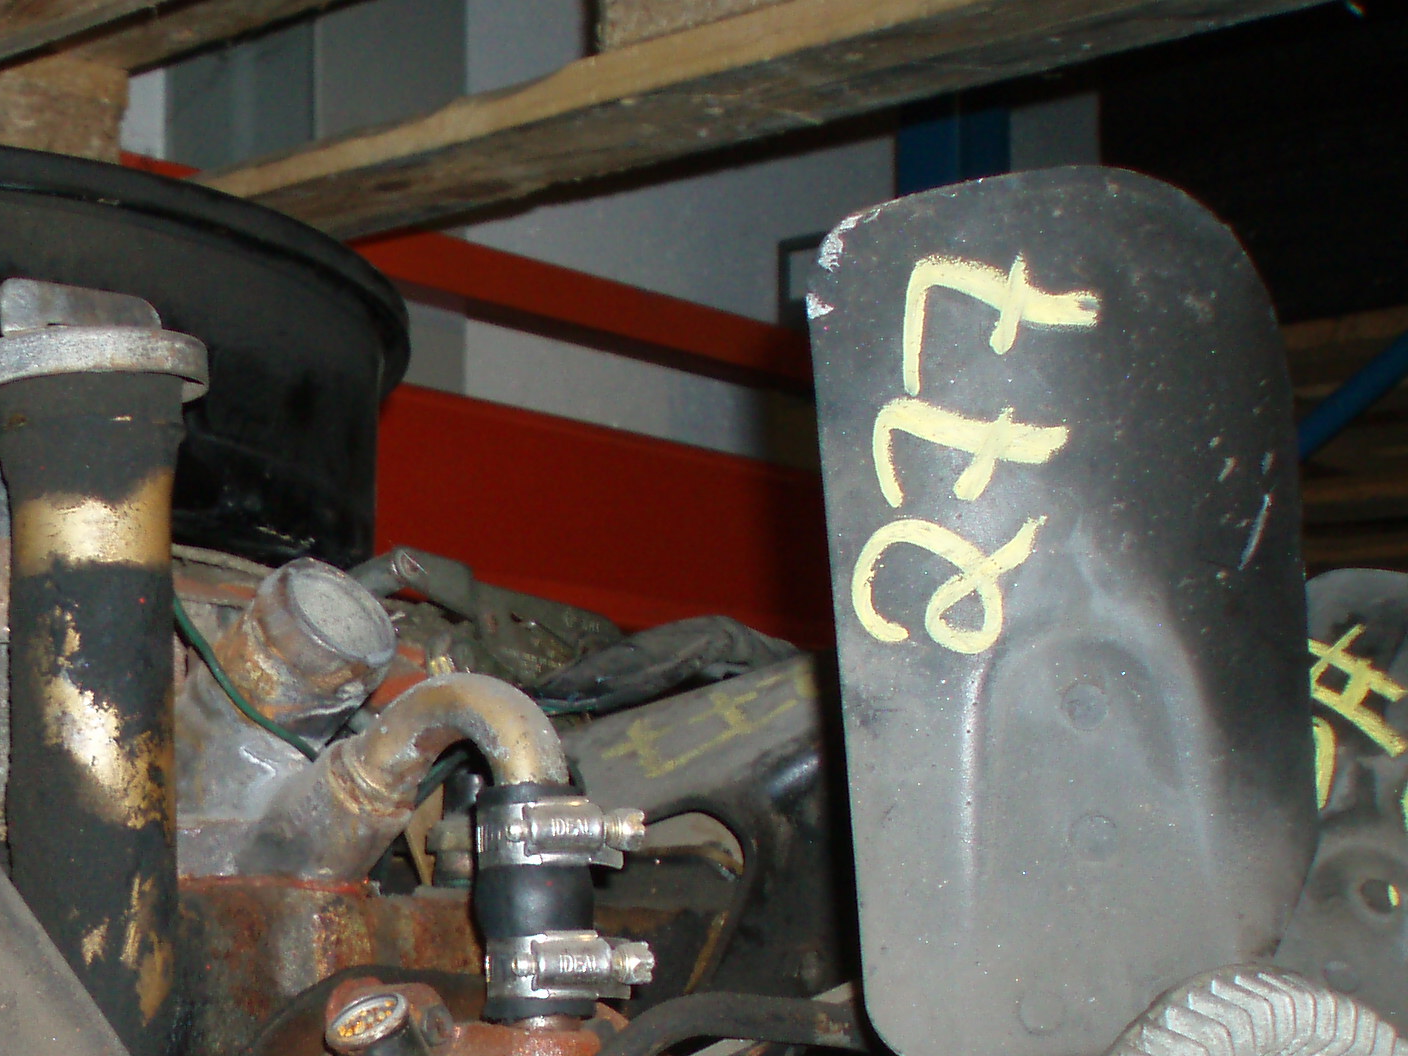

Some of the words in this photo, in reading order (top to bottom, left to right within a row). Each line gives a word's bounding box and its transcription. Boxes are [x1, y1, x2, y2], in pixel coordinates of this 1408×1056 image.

[852, 253, 1102, 654] 277
[551, 818, 593, 837] IDEAL
[559, 954, 600, 974] IDEAL
